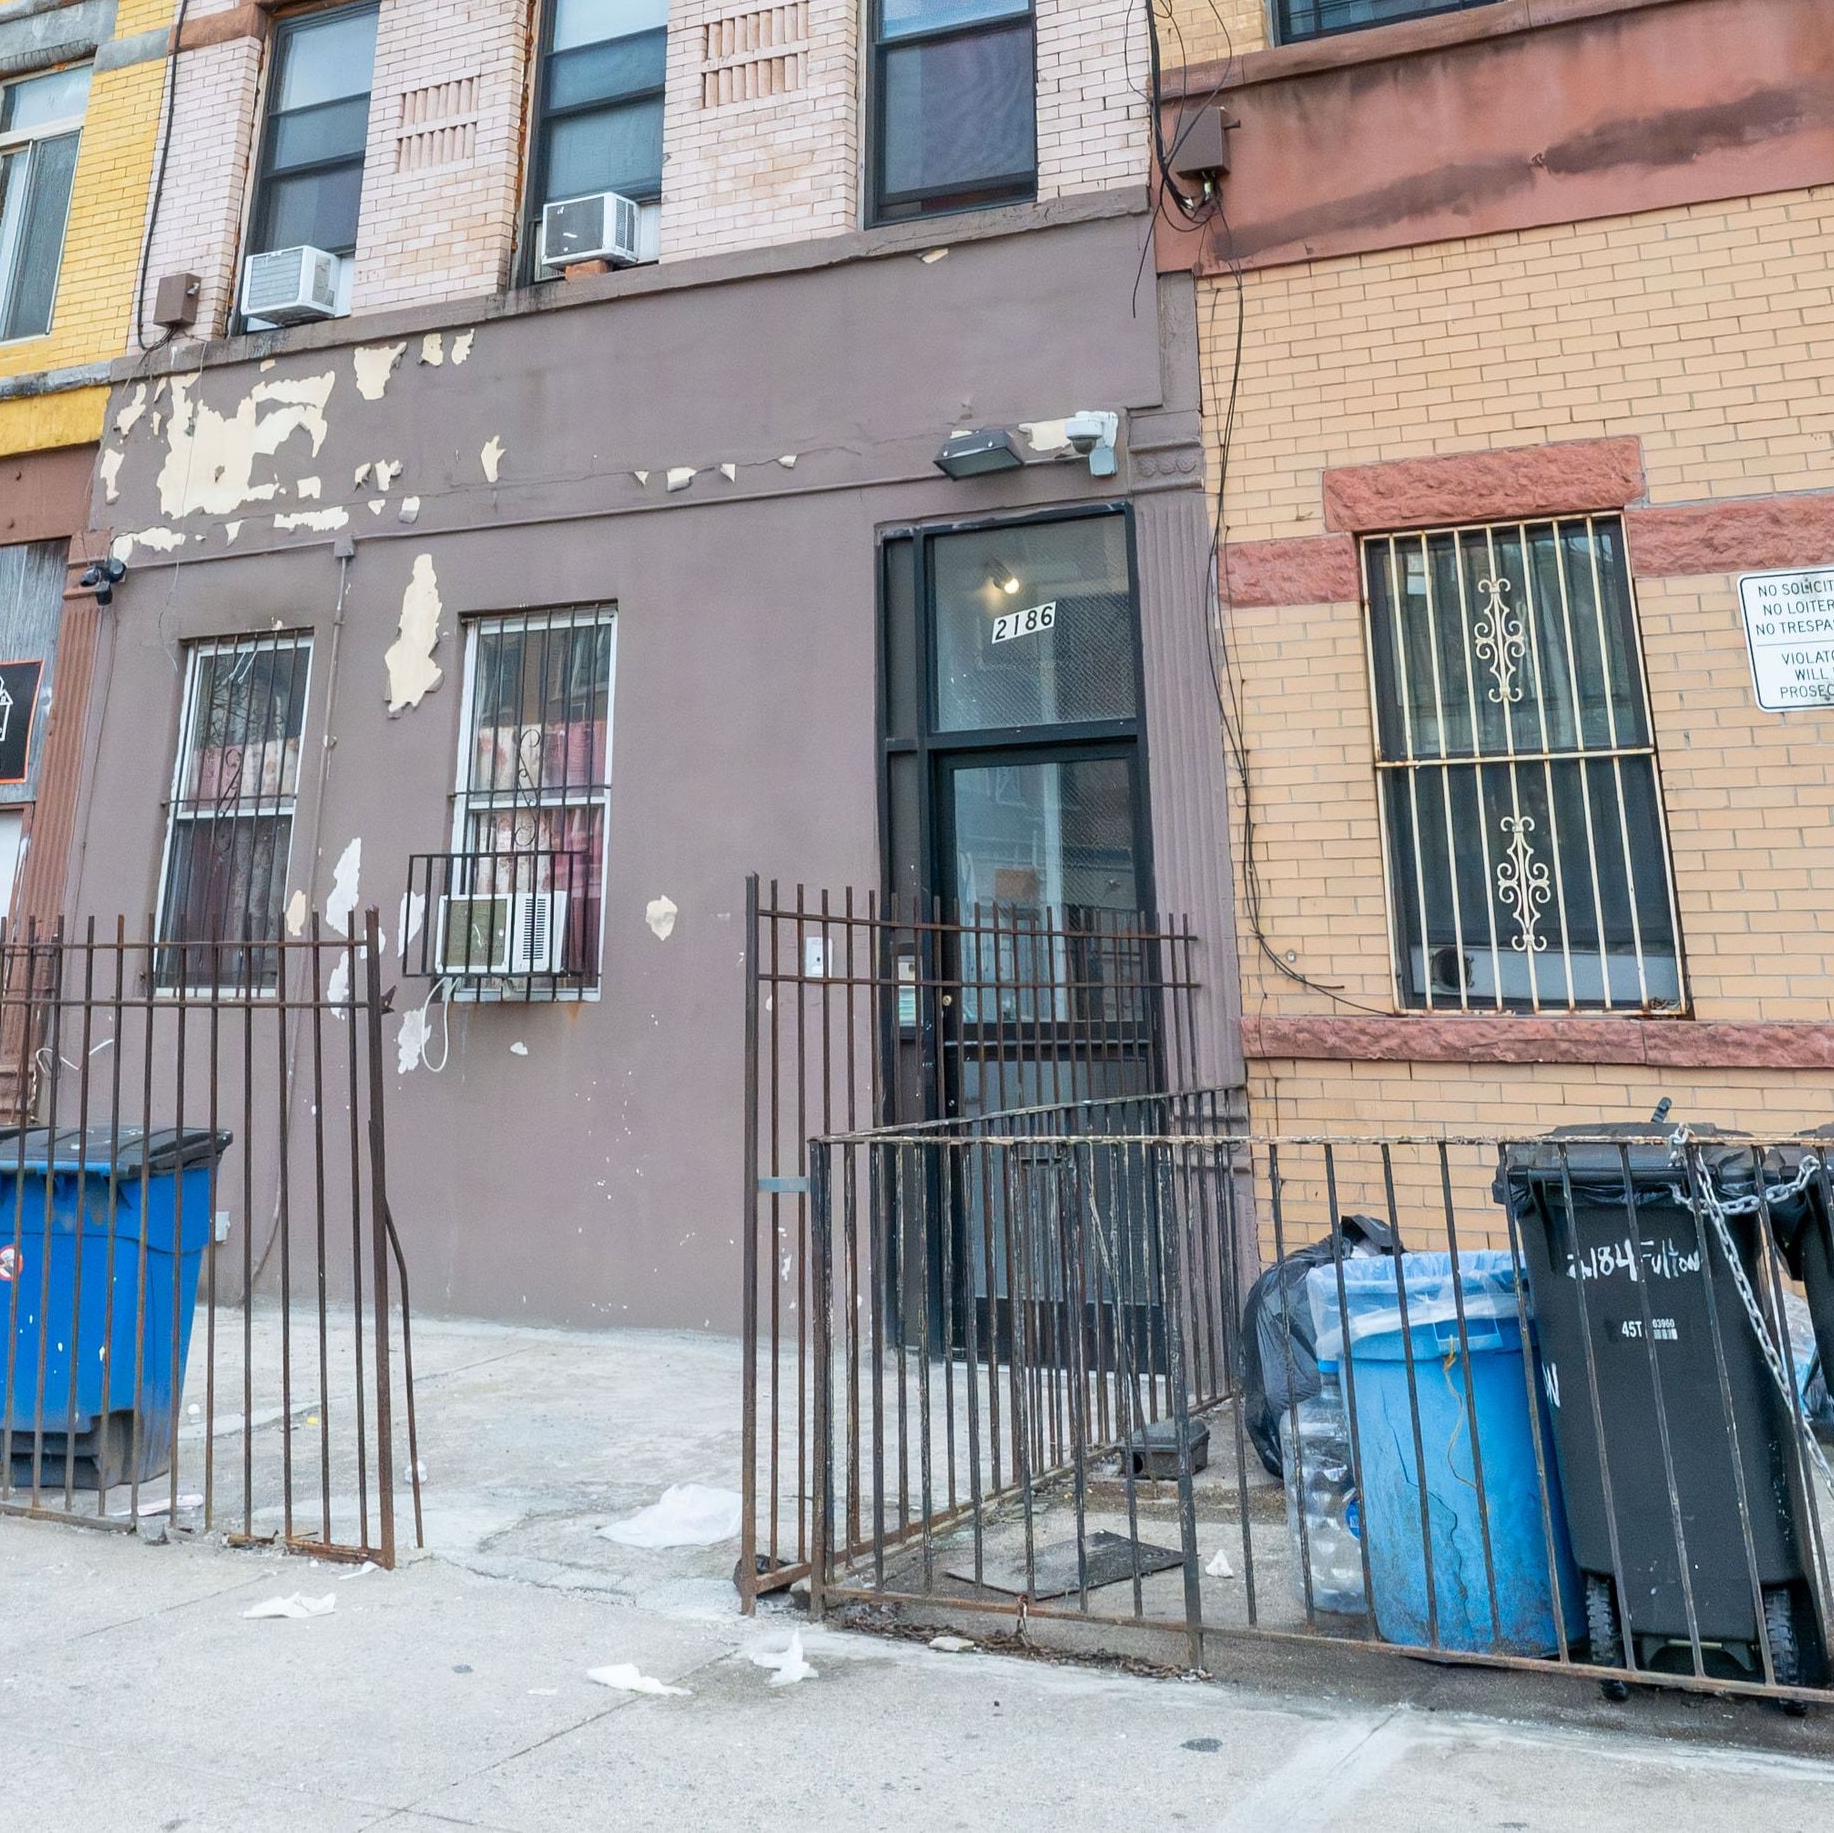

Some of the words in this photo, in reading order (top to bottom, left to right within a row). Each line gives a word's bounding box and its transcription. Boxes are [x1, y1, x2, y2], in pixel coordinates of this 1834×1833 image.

[1758, 584, 1777, 598] NO
[1763, 603, 1782, 616] NO
[995, 606, 1053, 640] 2186
[1755, 623, 1775, 636] NO
[1795, 667, 1829, 681] WILL
[1621, 1320, 1643, 1337] 45T
